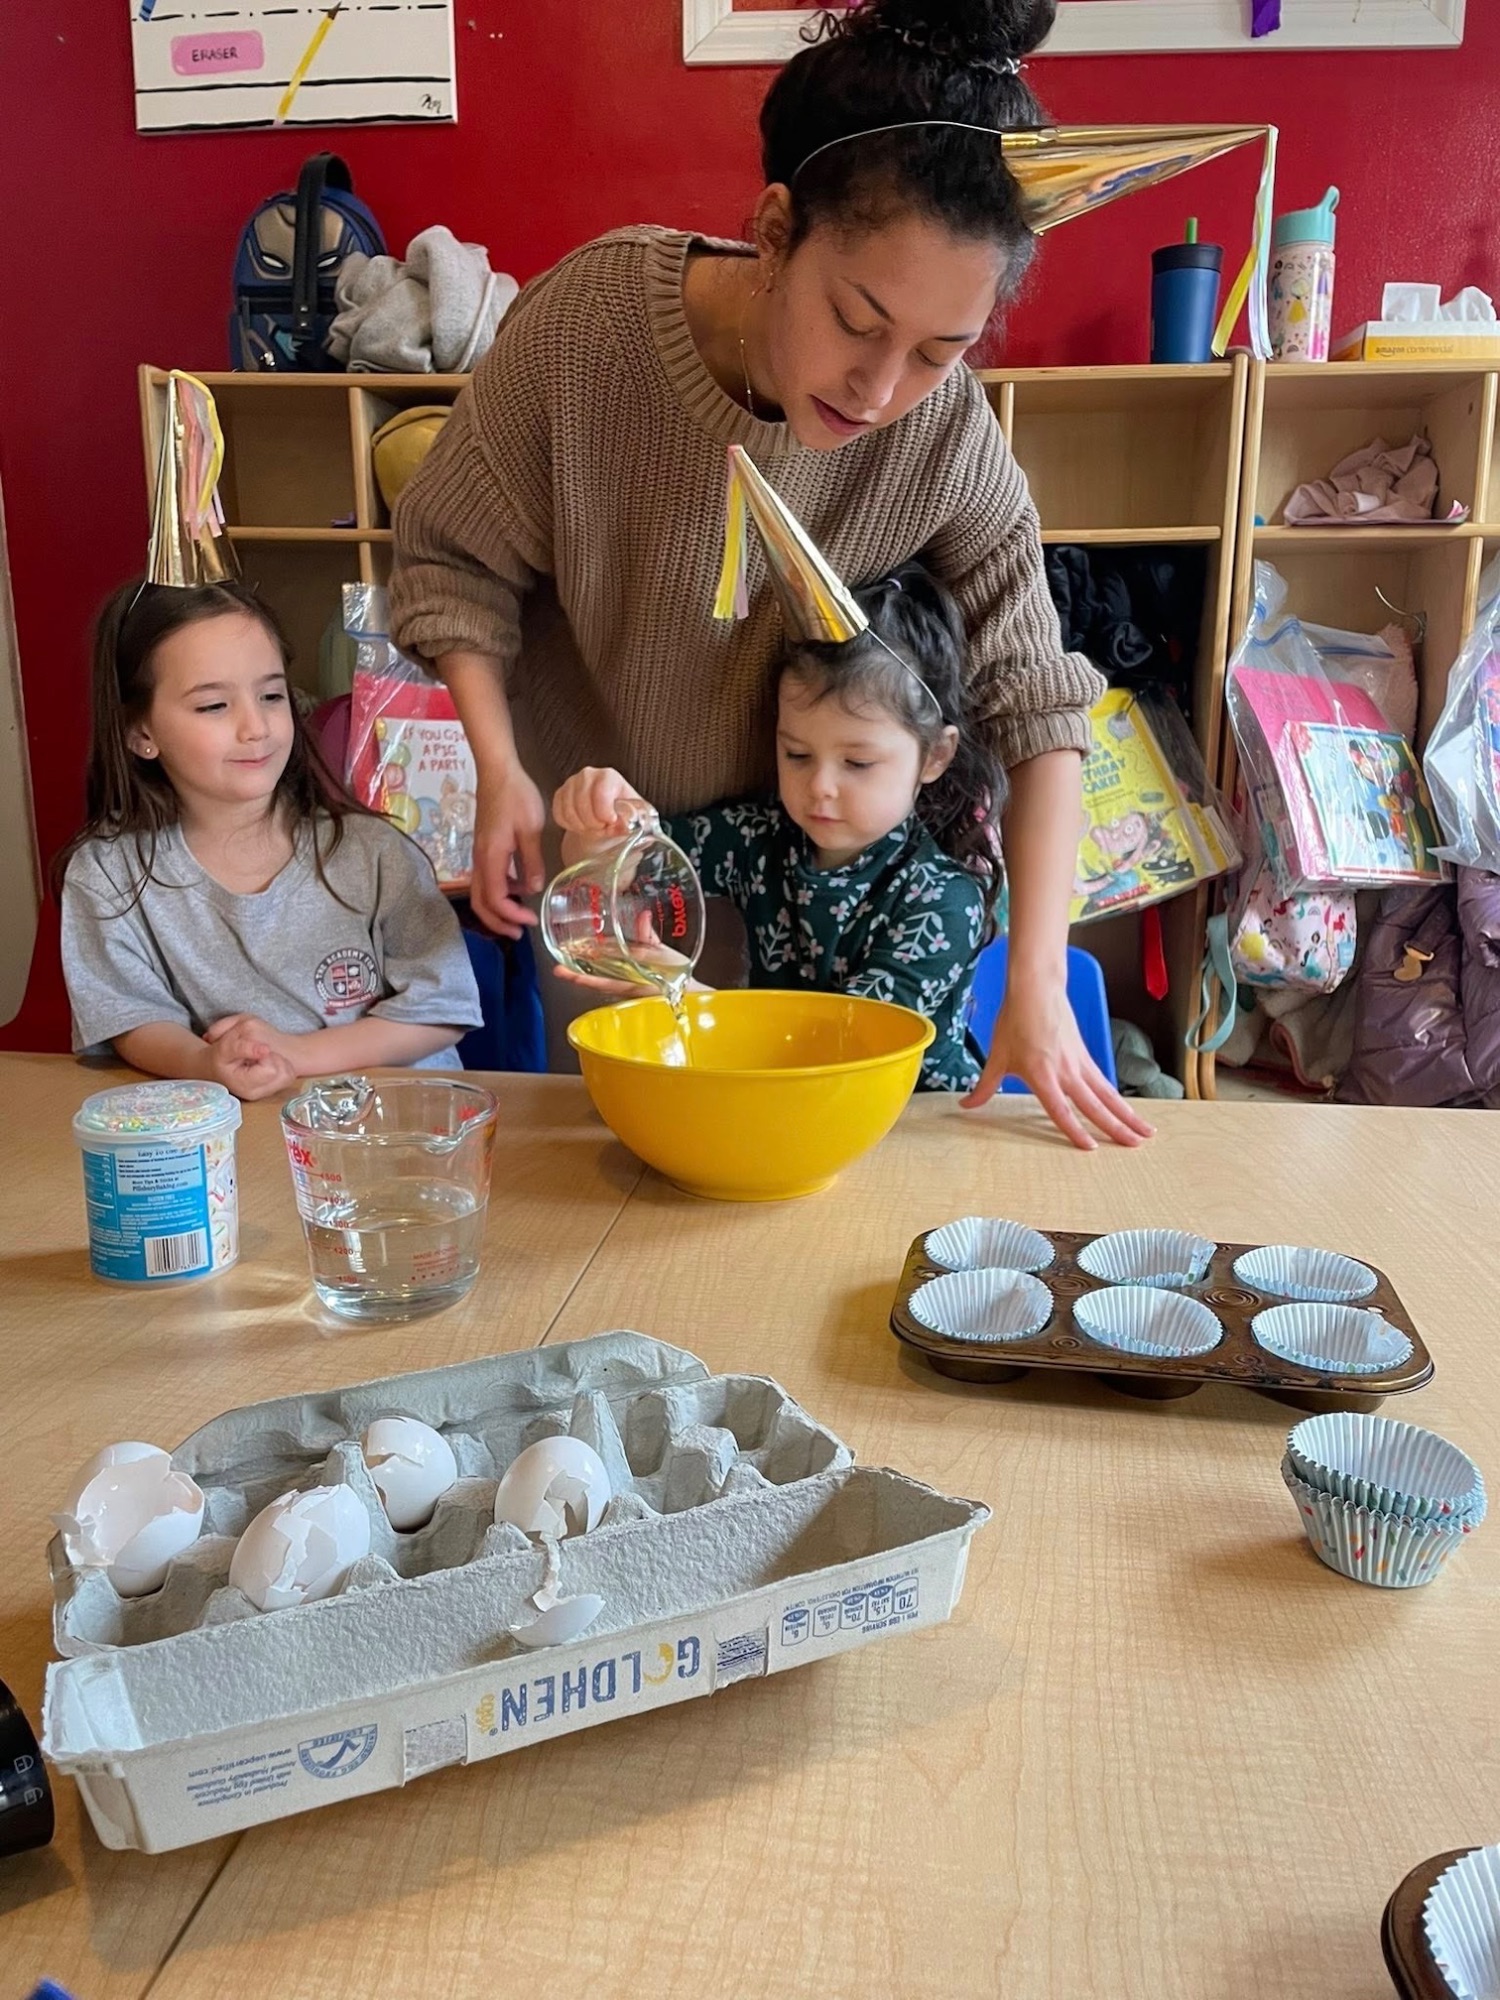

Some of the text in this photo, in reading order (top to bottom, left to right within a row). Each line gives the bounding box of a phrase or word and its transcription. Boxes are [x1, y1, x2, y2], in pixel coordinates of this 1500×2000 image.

[191, 47, 238, 62] ERASER
[1375, 346, 1405, 357] amazon
[420, 729, 441, 741] YOU
[423, 743, 457, 757] A PIG
[418, 758, 466, 772] A PARTY
[326, 949, 365, 965] ACADEMY
[841, 1588, 851, 1596] FOR
[851, 1578, 885, 1592] INFORMATION
[899, 1595, 913, 1610] 70
[906, 1611, 919, 1621] PER
[862, 1621, 888, 1634] SERVING
[253, 1780, 288, 1795] Produced
